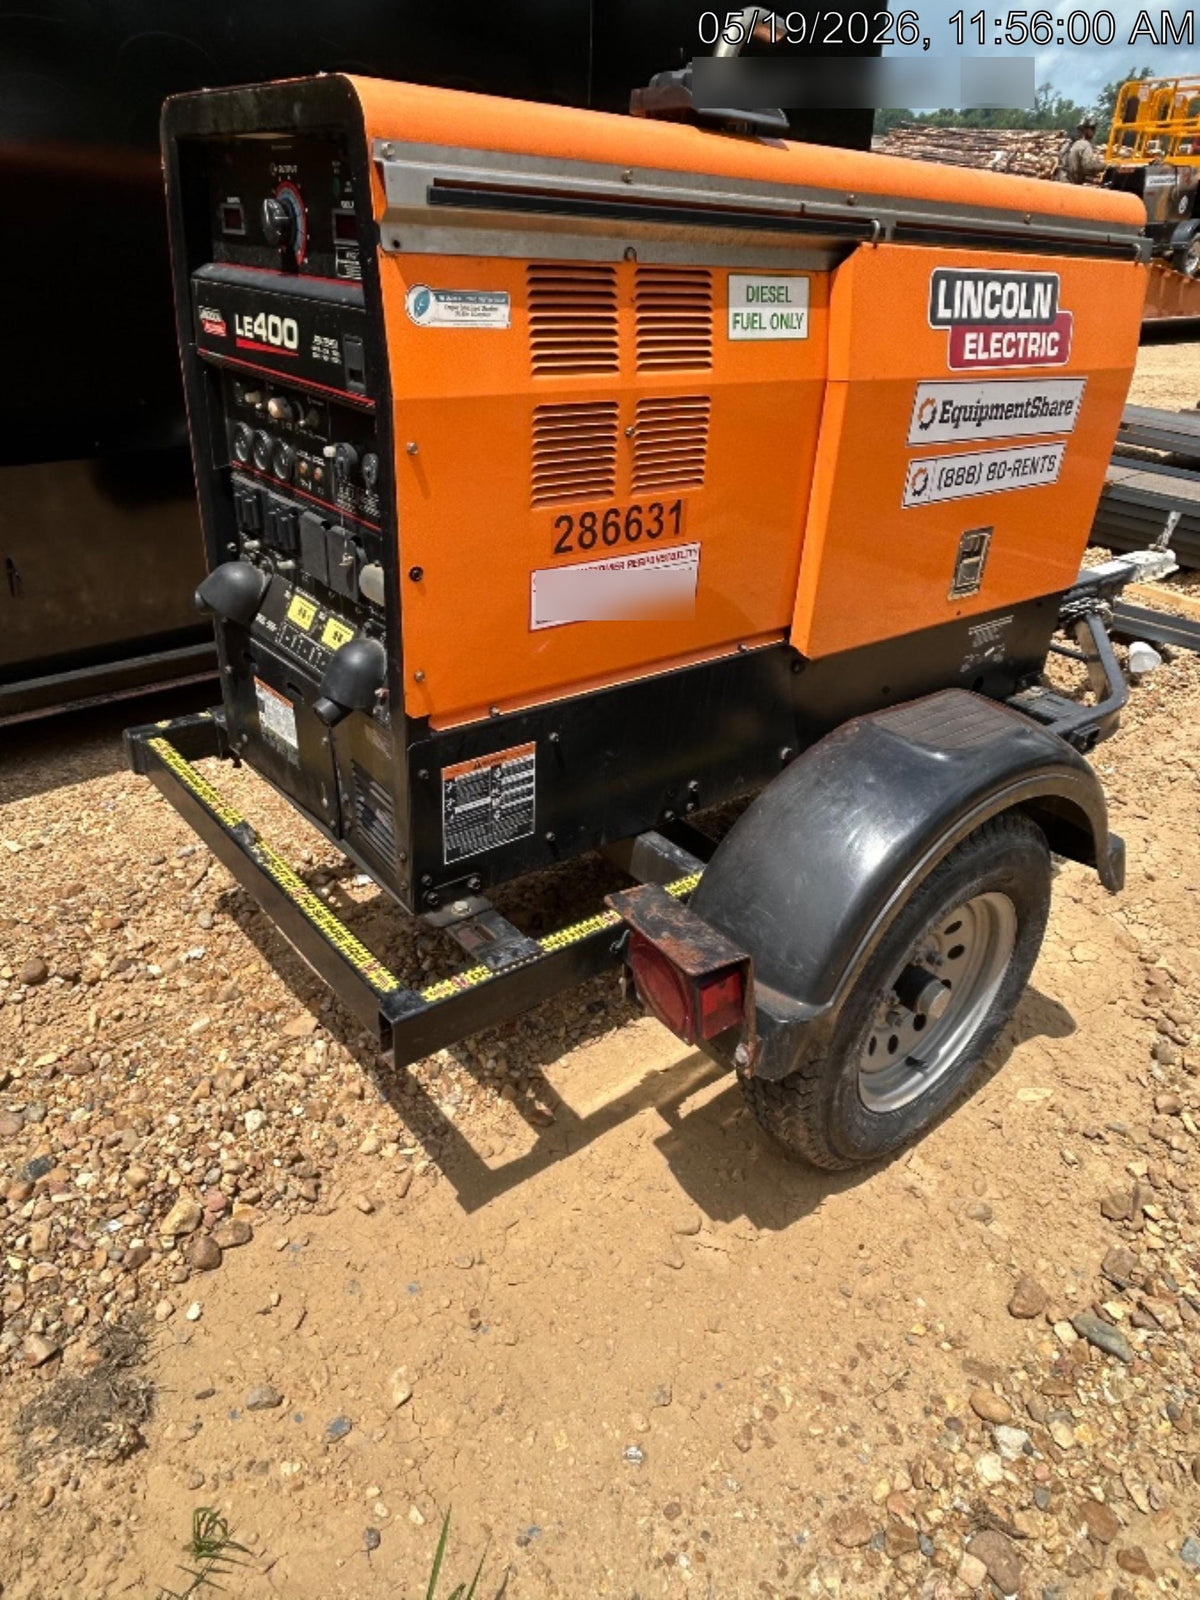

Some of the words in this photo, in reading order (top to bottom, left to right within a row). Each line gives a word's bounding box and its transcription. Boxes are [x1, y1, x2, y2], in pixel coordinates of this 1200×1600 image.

[746, 285, 792, 302] DIESEL
[937, 280, 1053, 319] LINCOLN
[235, 313, 299, 350] LE400
[732, 313, 767, 330] FUEL
[769, 312, 804, 330] ONLY
[963, 332, 1061, 360] ELECTRIC
[938, 396, 1073, 429] EquipmentShare
[937, 461, 982, 490] (888)
[986, 455, 1056, 482] 80-RENTS
[553, 499, 683, 554] 286631
